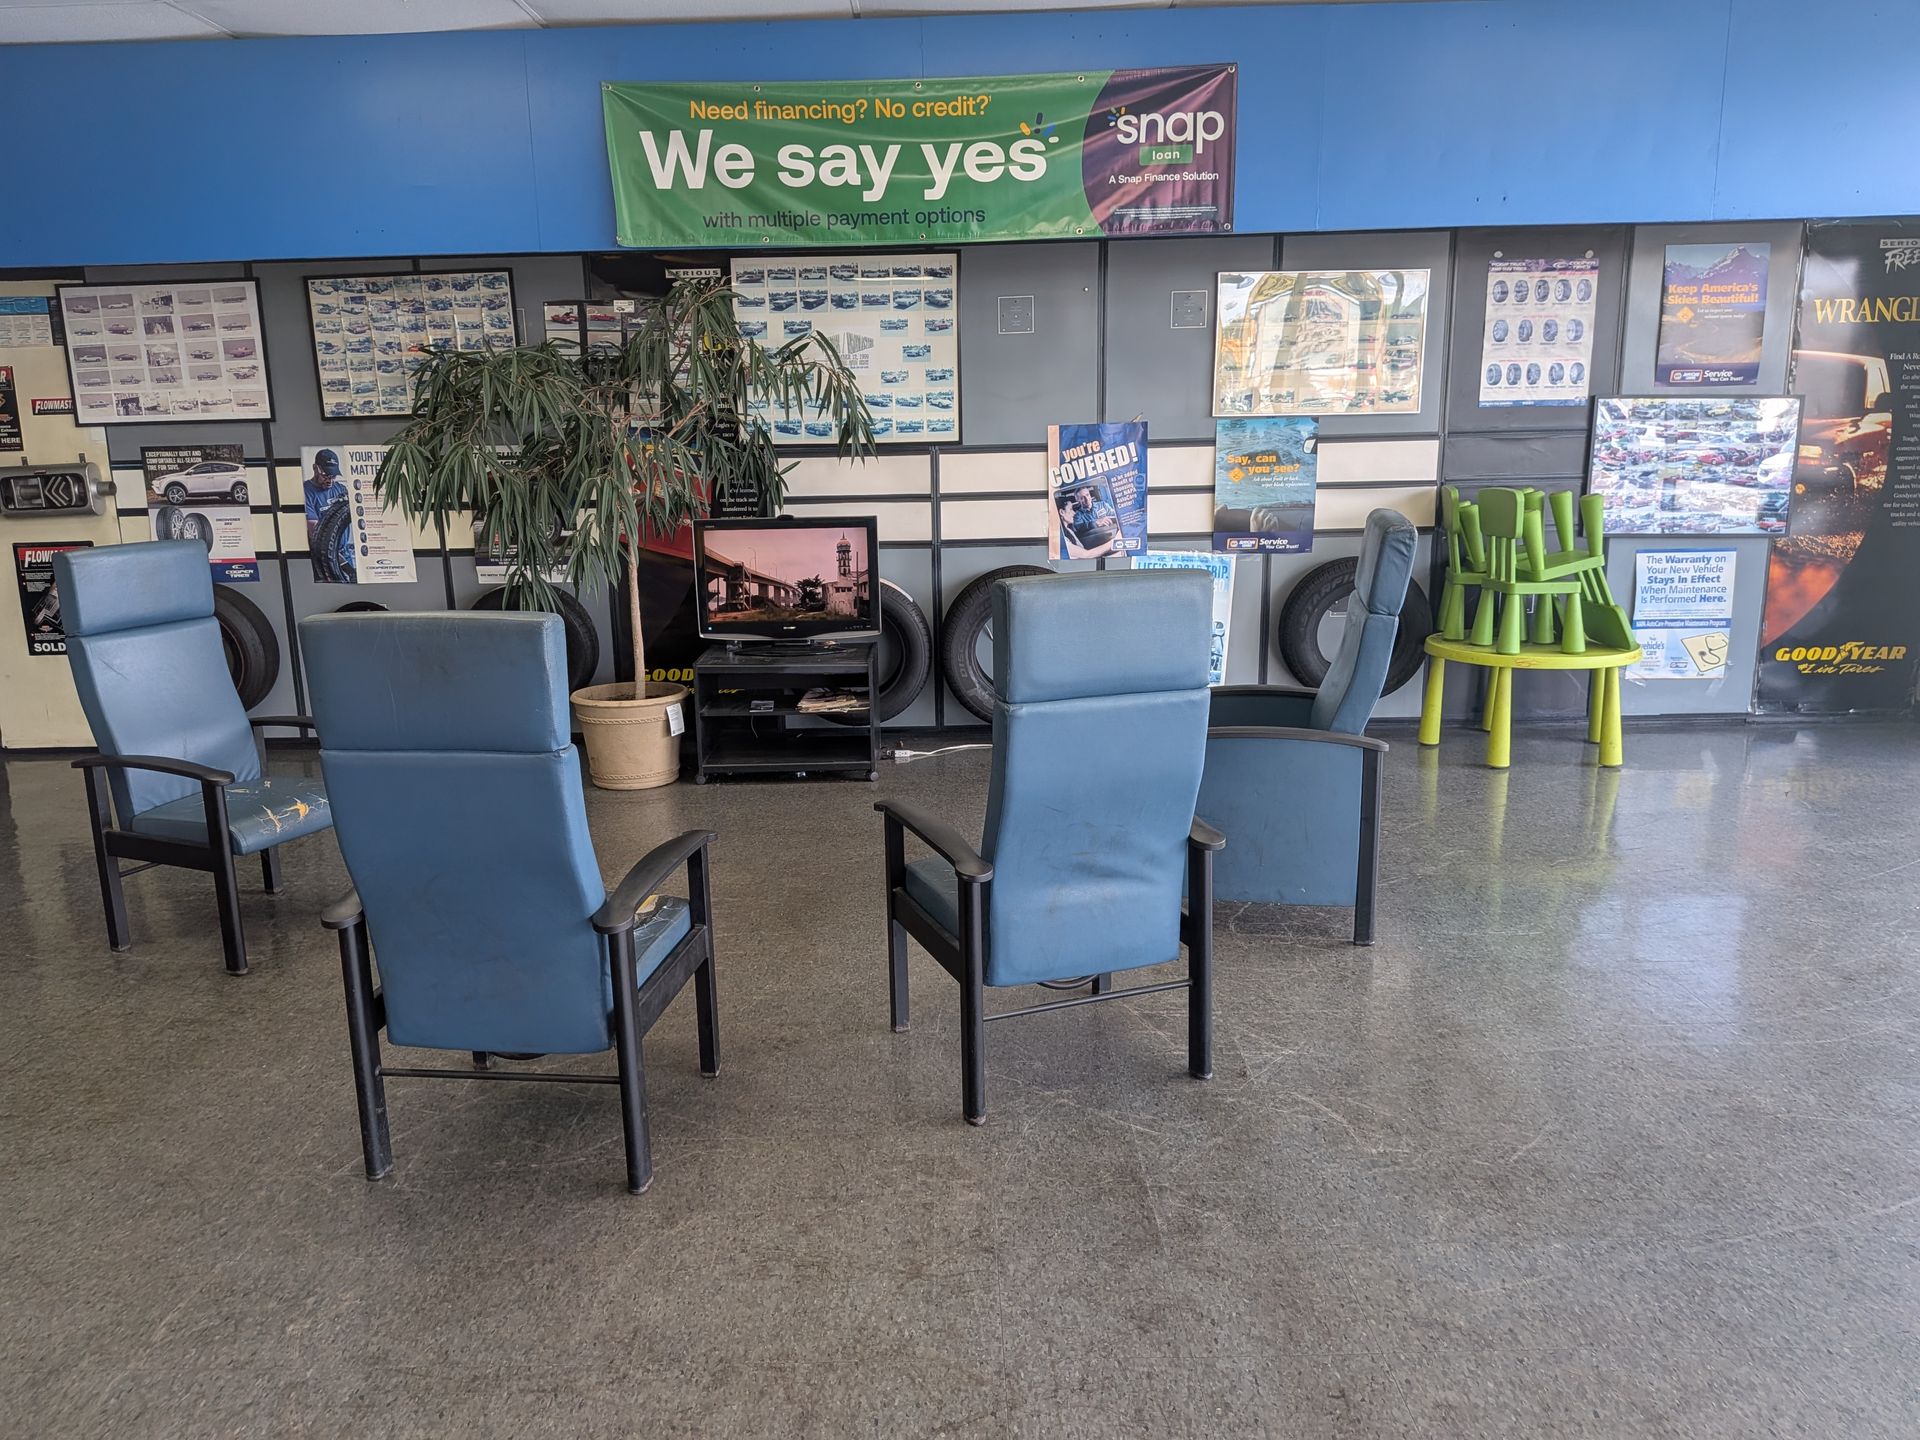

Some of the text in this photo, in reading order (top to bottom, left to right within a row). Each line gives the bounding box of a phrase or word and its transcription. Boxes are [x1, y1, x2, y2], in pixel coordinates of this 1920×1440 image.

[689, 99, 749, 120] Need
[754, 97, 868, 124] financing?
[875, 97, 906, 118] No
[1116, 110, 1225, 154] snap
[1151, 150, 1180, 161] loan
[638, 129, 1047, 202] We say yes
[1108, 170, 1219, 185] A Snap Finance Solution
[703, 207, 986, 231] with multiple payment options
[1885, 248, 1920, 274] FREE
[1668, 283, 1759, 295] Keep America's
[1667, 293, 1759, 304] Skies Beautiful!
[1814, 296, 1920, 324] WRANGL
[1903, 363, 1920, 371] Neve
[1703, 369, 1733, 378] Service
[35, 399, 73, 414] FLOWMAST
[145, 450, 178, 458] EXCEPTIONALLY
[348, 451, 373, 462] YOUR
[1062, 440, 1101, 462] you're
[146, 456, 202, 465] COMFORTABLE ALL-SEASON
[1050, 442, 1139, 488] COVERED!
[1227, 454, 1277, 465] Say, can
[350, 464, 381, 475] MATTE
[1247, 463, 1300, 475] you see?
[1646, 555, 1663, 564] The
[1664, 555, 1711, 565] Warranty
[1646, 564, 1724, 574] Your New Vehicle
[1647, 575, 1721, 586] Stays In Effect
[1640, 585, 1727, 594] When Maintenance
[1649, 594, 1696, 604] Performed
[1698, 594, 1727, 603] Here.
[34, 642, 67, 652] SOLD
[1775, 645, 1907, 662] GOODYEAR
[1815, 664, 1838, 674] in
[1839, 663, 1885, 675] Tires
